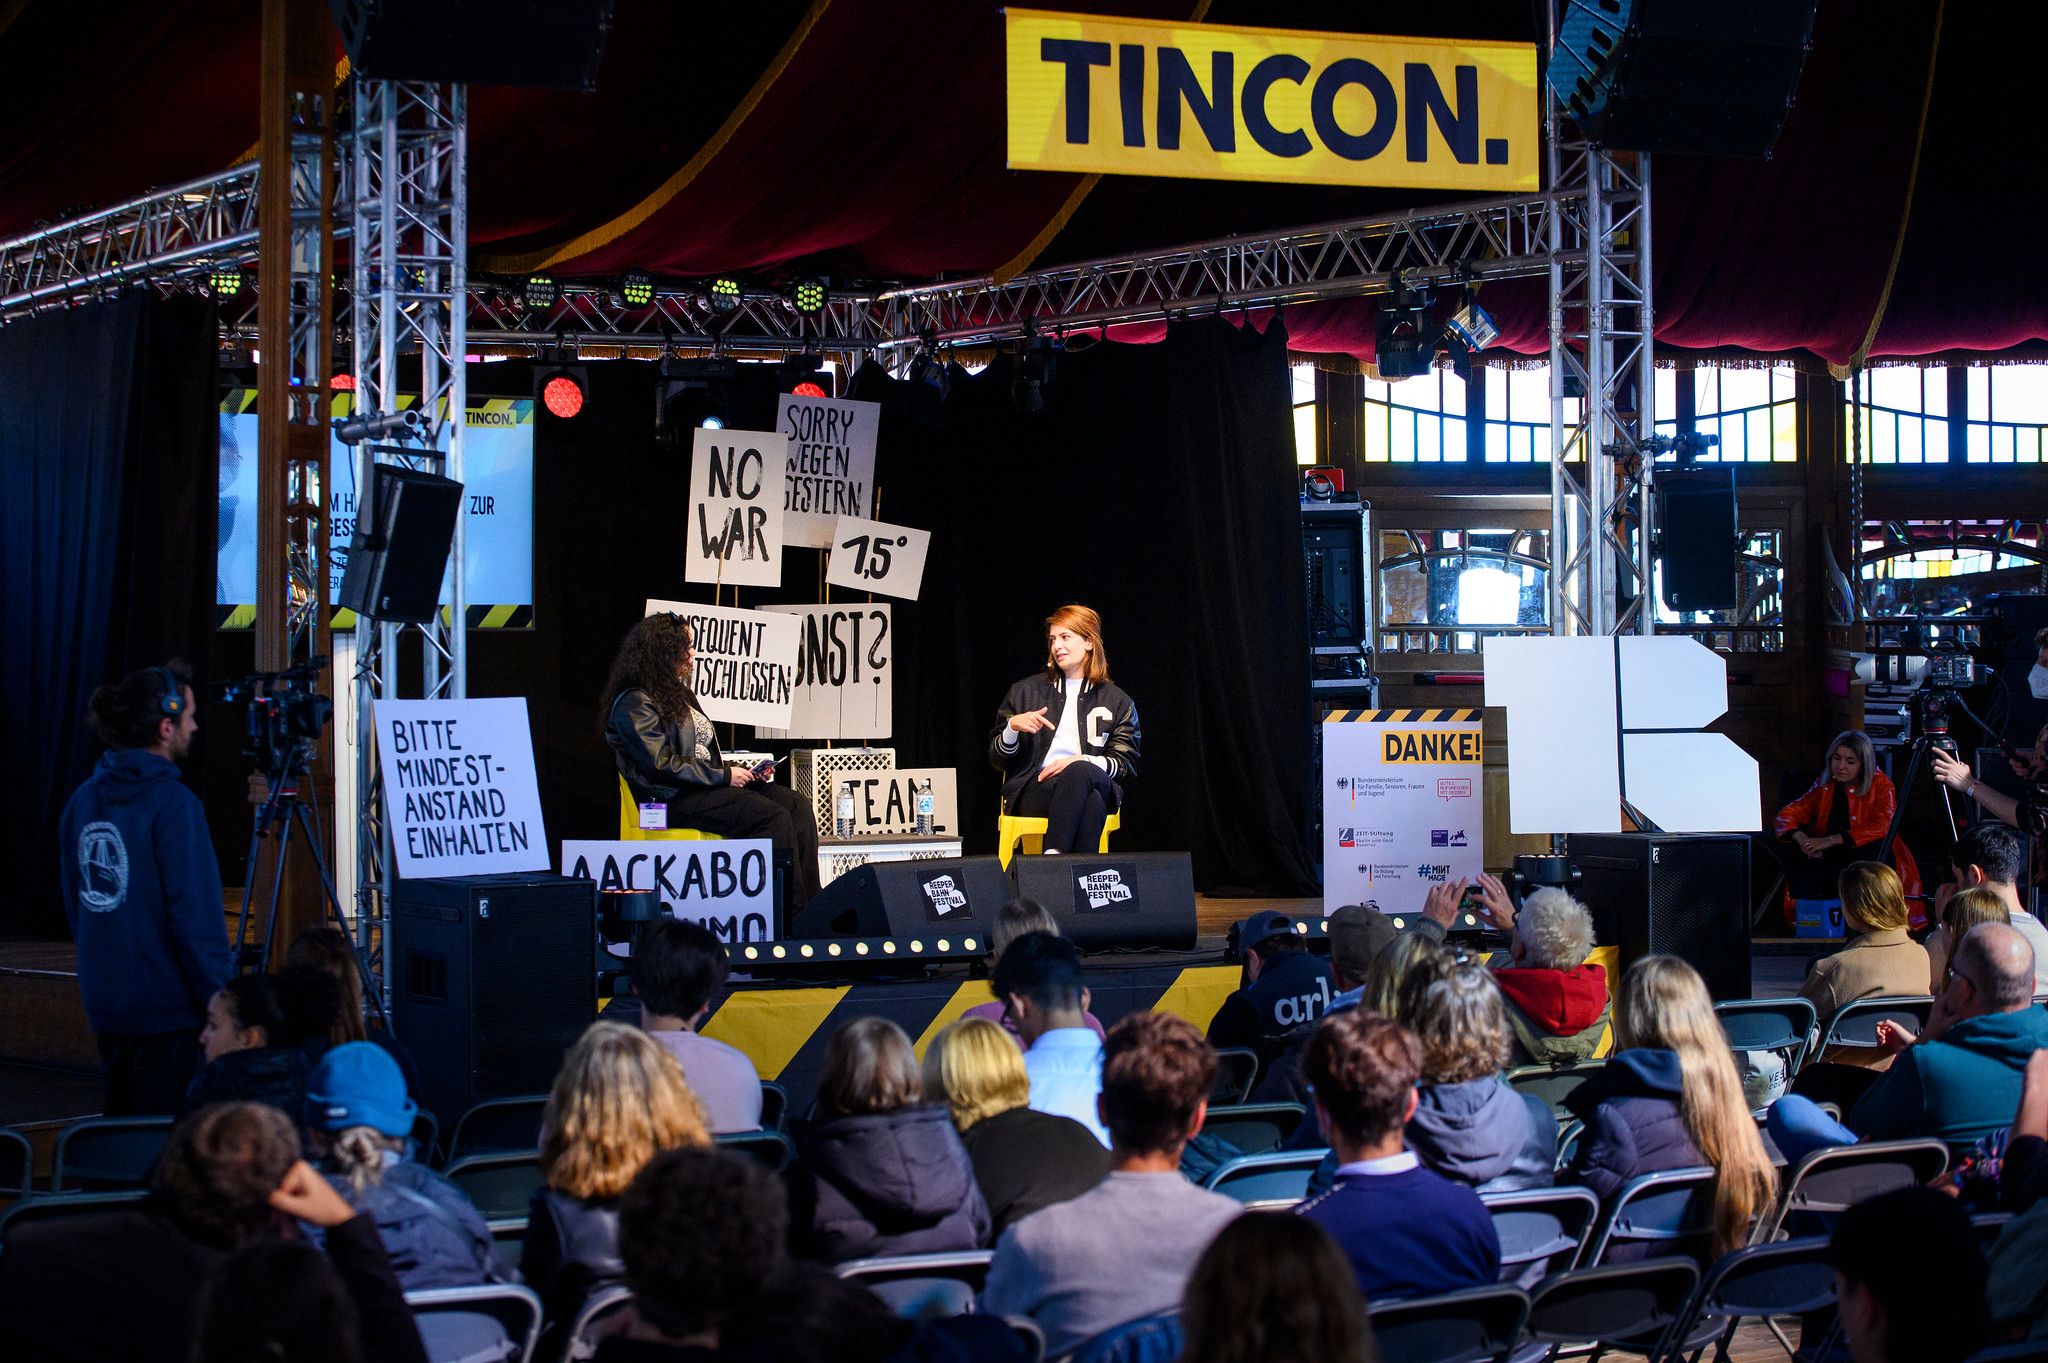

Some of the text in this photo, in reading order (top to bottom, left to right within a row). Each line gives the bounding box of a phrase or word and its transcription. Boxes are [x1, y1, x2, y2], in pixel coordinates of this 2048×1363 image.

[1040, 37, 1509, 165] TINCON.
[465, 411, 513, 425] TINCON.
[785, 404, 854, 445] SORRY
[707, 446, 764, 500] NO
[470, 496, 495, 516] ZUR
[697, 503, 769, 561] WAR
[694, 657, 792, 705] TSCHLOSSEN
[392, 719, 462, 755] BITTE
[1087, 706, 1113, 747] C
[1385, 733, 1481, 762] DANKE!
[396, 754, 506, 789] MINDEST-
[404, 788, 506, 823] ANSTAND
[407, 820, 529, 859] EINHALTEN
[929, 878, 954, 890] REEPER
[931, 888, 951, 900] BAHN
[1086, 873, 1119, 883] REEPER
[1087, 882, 1112, 891] BAHN
[1088, 890, 1129, 900] FESTIVAL
[933, 894, 965, 907] FESTIVAL
[1274, 976, 1341, 1025] arl
